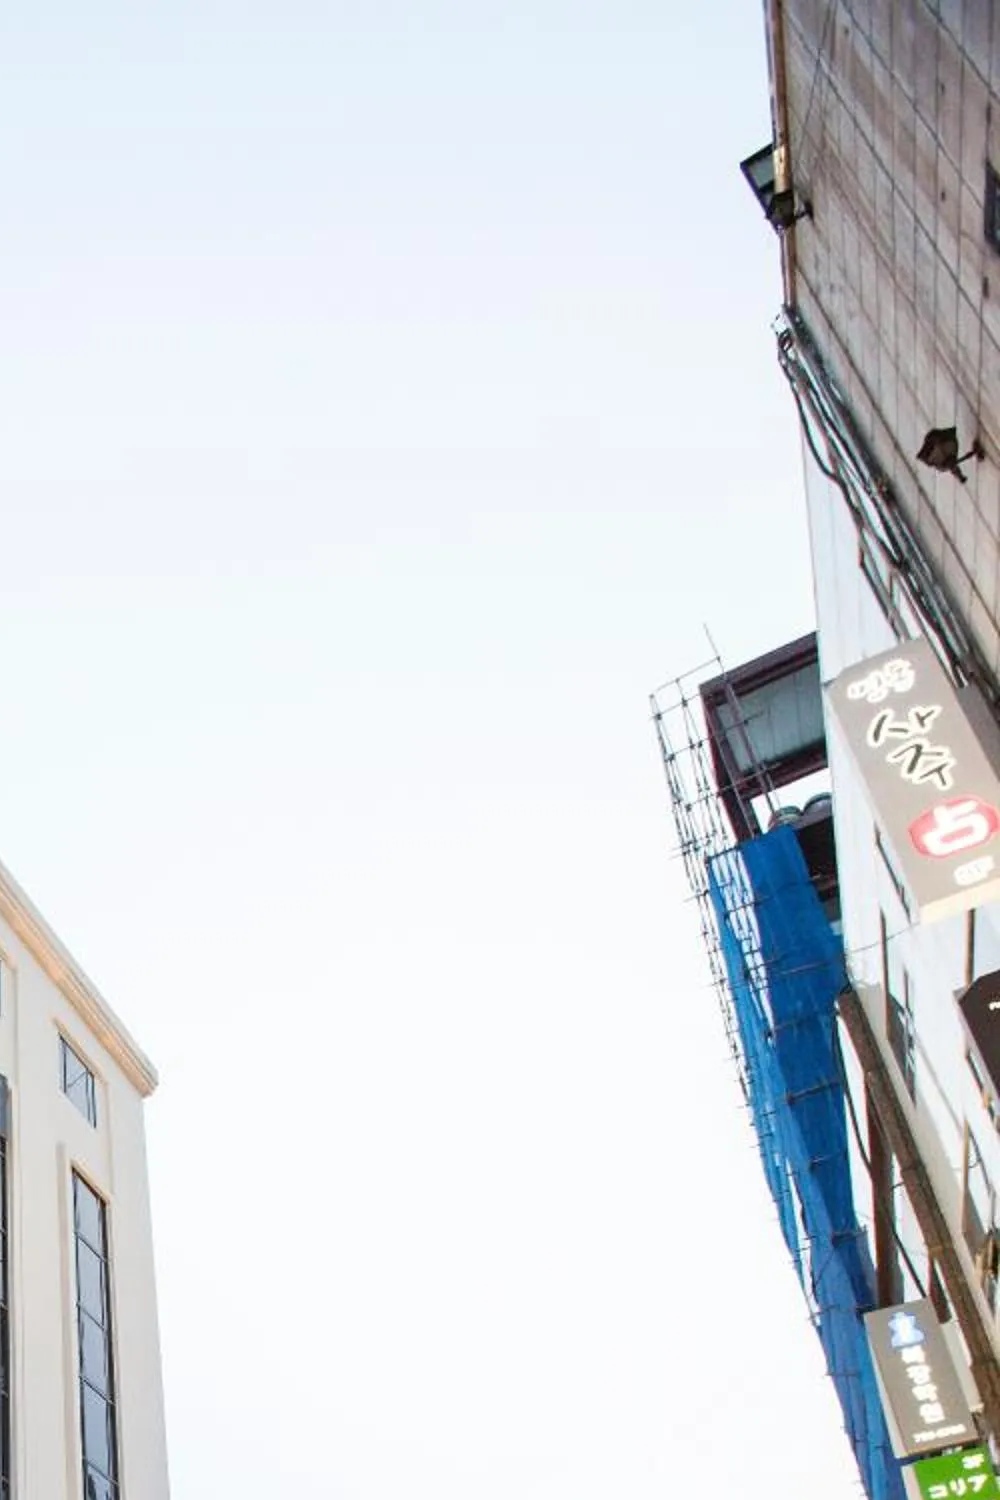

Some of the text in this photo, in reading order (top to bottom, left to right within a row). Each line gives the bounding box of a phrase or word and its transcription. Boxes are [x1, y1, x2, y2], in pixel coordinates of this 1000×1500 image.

[867, 705, 957, 790] 사주
[928, 1474, 988, 1499] コリア
